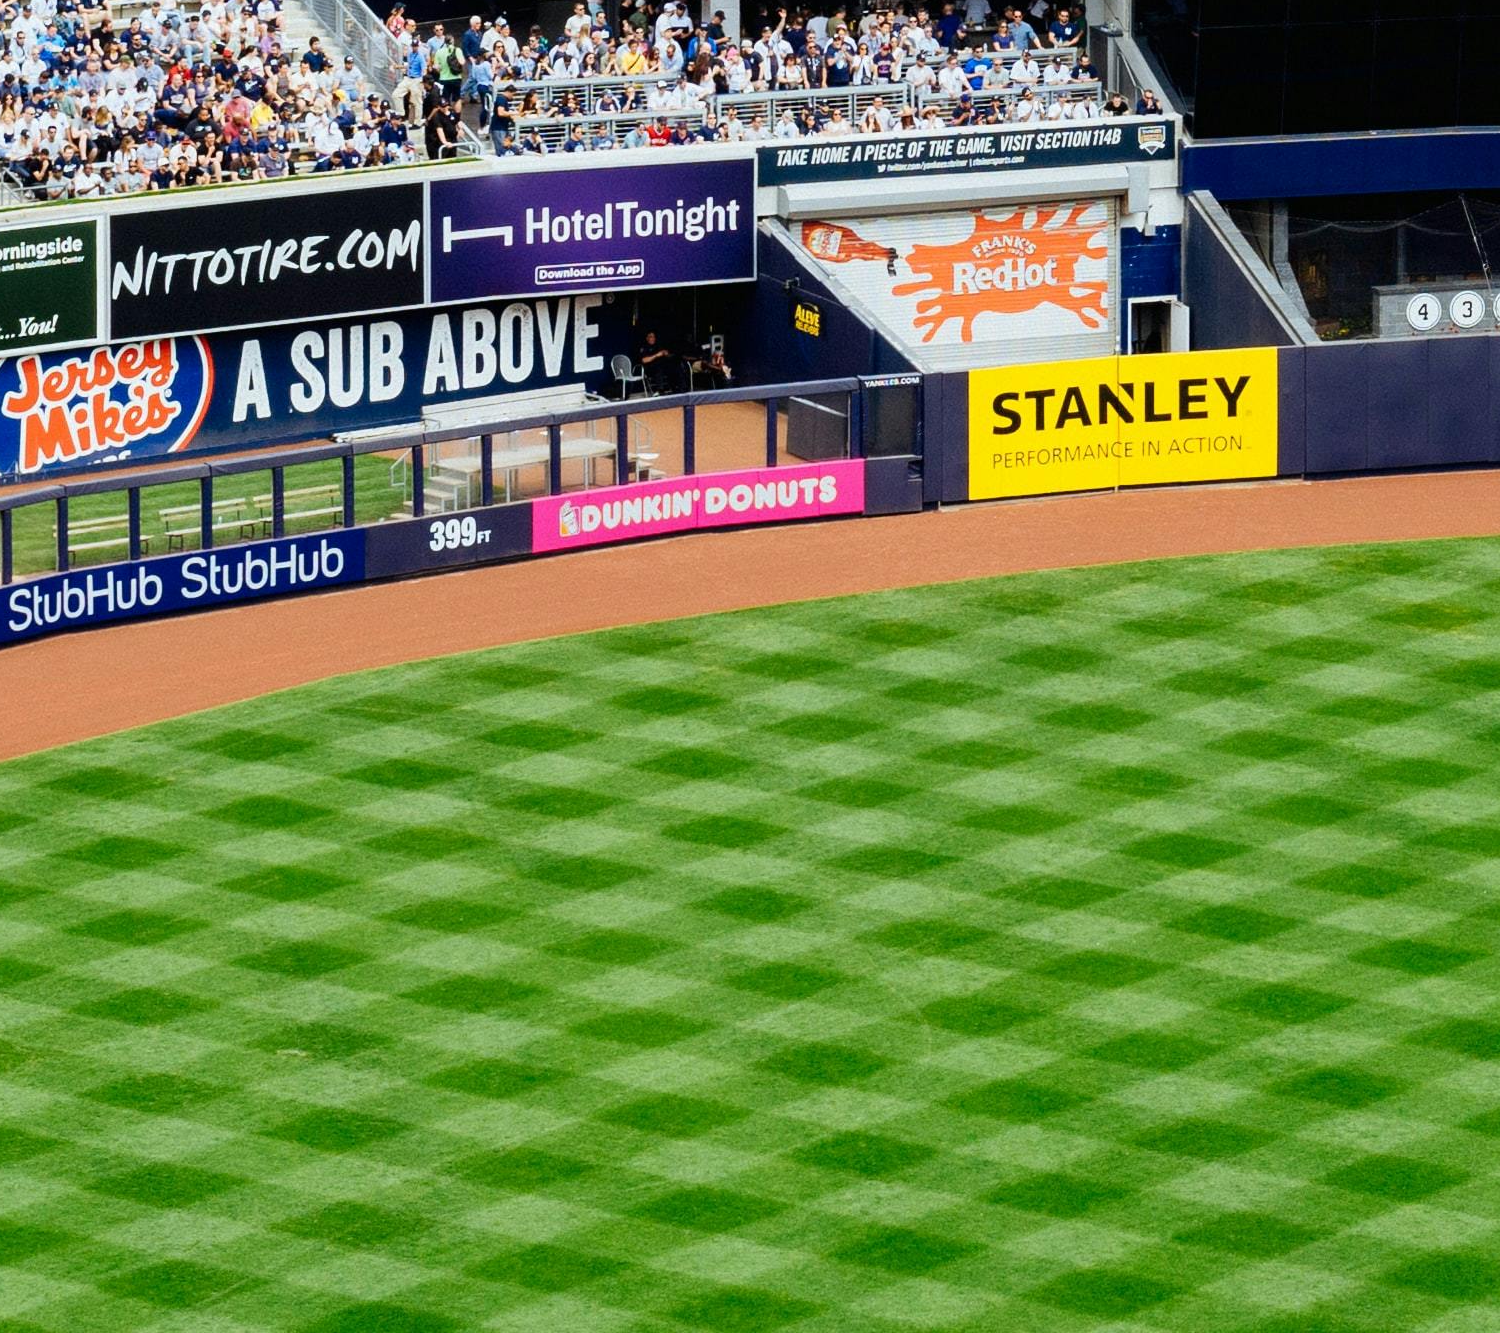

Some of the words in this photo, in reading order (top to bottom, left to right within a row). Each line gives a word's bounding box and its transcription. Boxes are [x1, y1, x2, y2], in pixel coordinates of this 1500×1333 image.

[777, 149, 808, 166] TAKE
[811, 148, 849, 164] HOME
[852, 146, 862, 162] A
[863, 144, 904, 161] PIECE
[907, 142, 926, 159] OF
[929, 140, 953, 157] THE
[956, 138, 995, 156] GAME,
[1000, 135, 1031, 152] VISIT
[1035, 132, 1090, 149] SECTION
[1092, 130, 1121, 147] 114B
[526, 198, 739, 245] HotelTonight
[113, 218, 419, 300] NITTOTIRE.COM
[538, 265, 594, 283] Download
[597, 264, 614, 279] the
[618, 262, 641, 282] App
[952, 258, 1057, 295] RedHot
[0, 339, 173, 415] Jersey
[232, 341, 270, 424] A
[290, 322, 405, 413] SUB
[424, 295, 604, 393] ABOVE
[18, 388, 180, 469] Mike's
[993, 376, 1251, 435] STANLEY
[993, 441, 1136, 470] PERFORMANCE
[1144, 439, 1161, 458] IN
[706, 474, 838, 515] DONUTS
[9, 568, 162, 633] StubHub
[181, 540, 344, 601] StubHub
